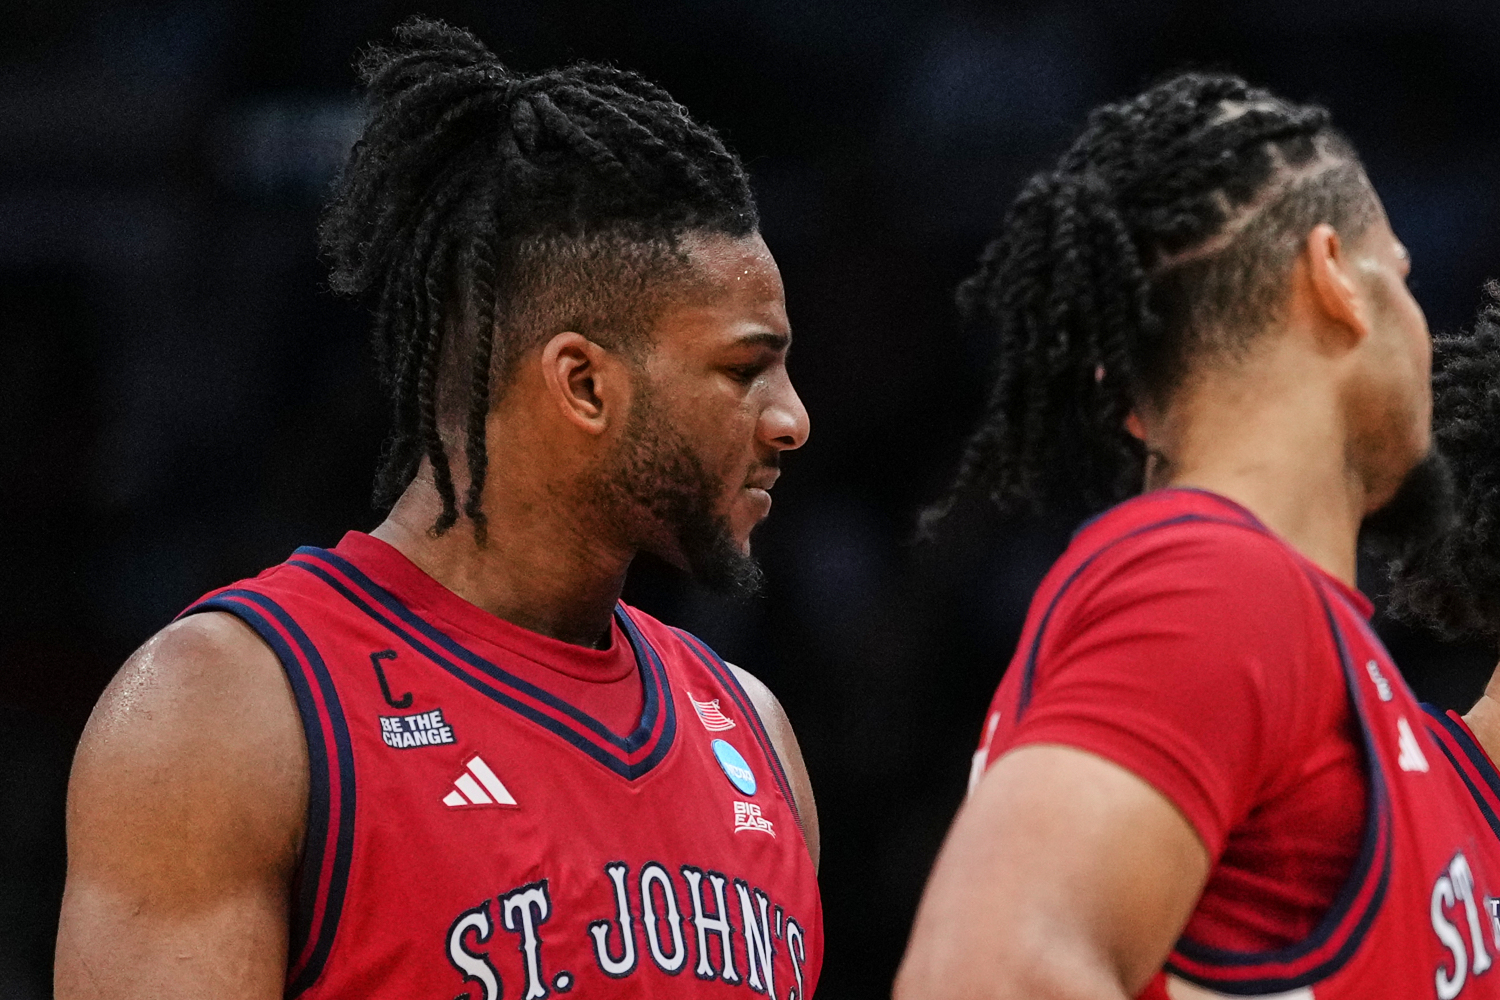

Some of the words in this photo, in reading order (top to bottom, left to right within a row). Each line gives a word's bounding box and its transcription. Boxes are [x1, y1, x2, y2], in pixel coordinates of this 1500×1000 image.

[380, 717, 403, 733] BE
[404, 710, 444, 731] THE
[383, 726, 454, 748] CHANGE
[733, 801, 761, 816] BIG
[734, 814, 773, 830] EAST
